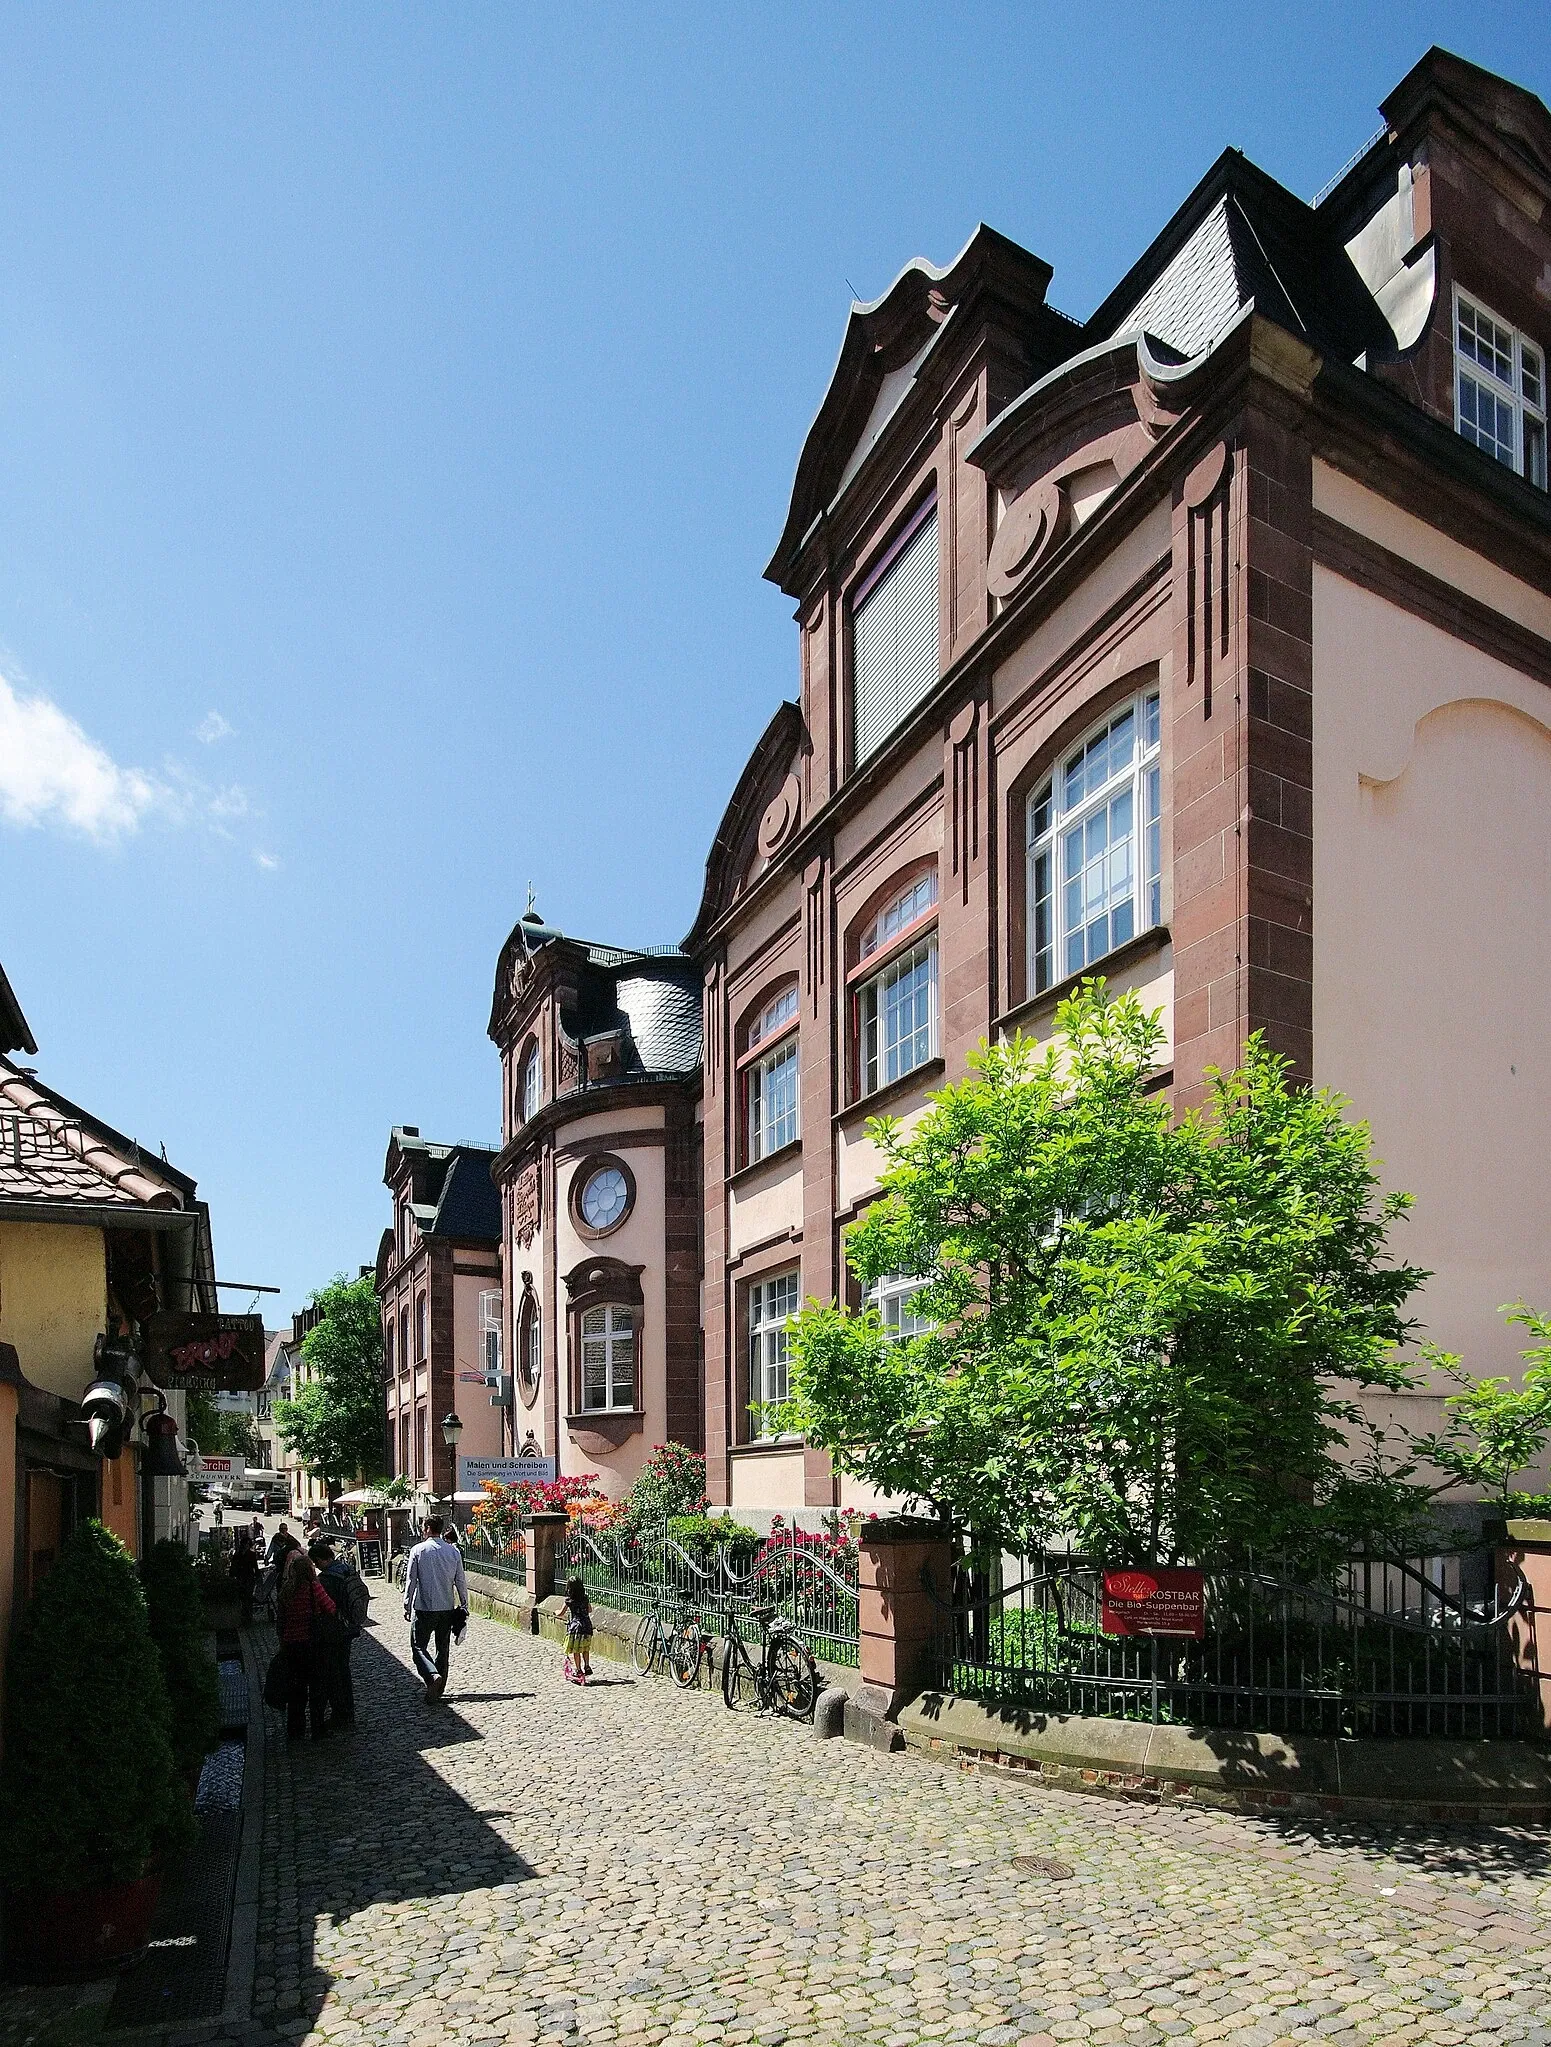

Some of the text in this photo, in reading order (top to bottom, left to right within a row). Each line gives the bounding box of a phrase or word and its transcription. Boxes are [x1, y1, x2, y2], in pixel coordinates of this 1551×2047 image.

[466, 1461, 548, 1469] Malen und Schreiben
[1149, 1591, 1200, 1600] KOSTBAR
[1108, 1600, 1200, 1611] Die Bio-Suppenbar
